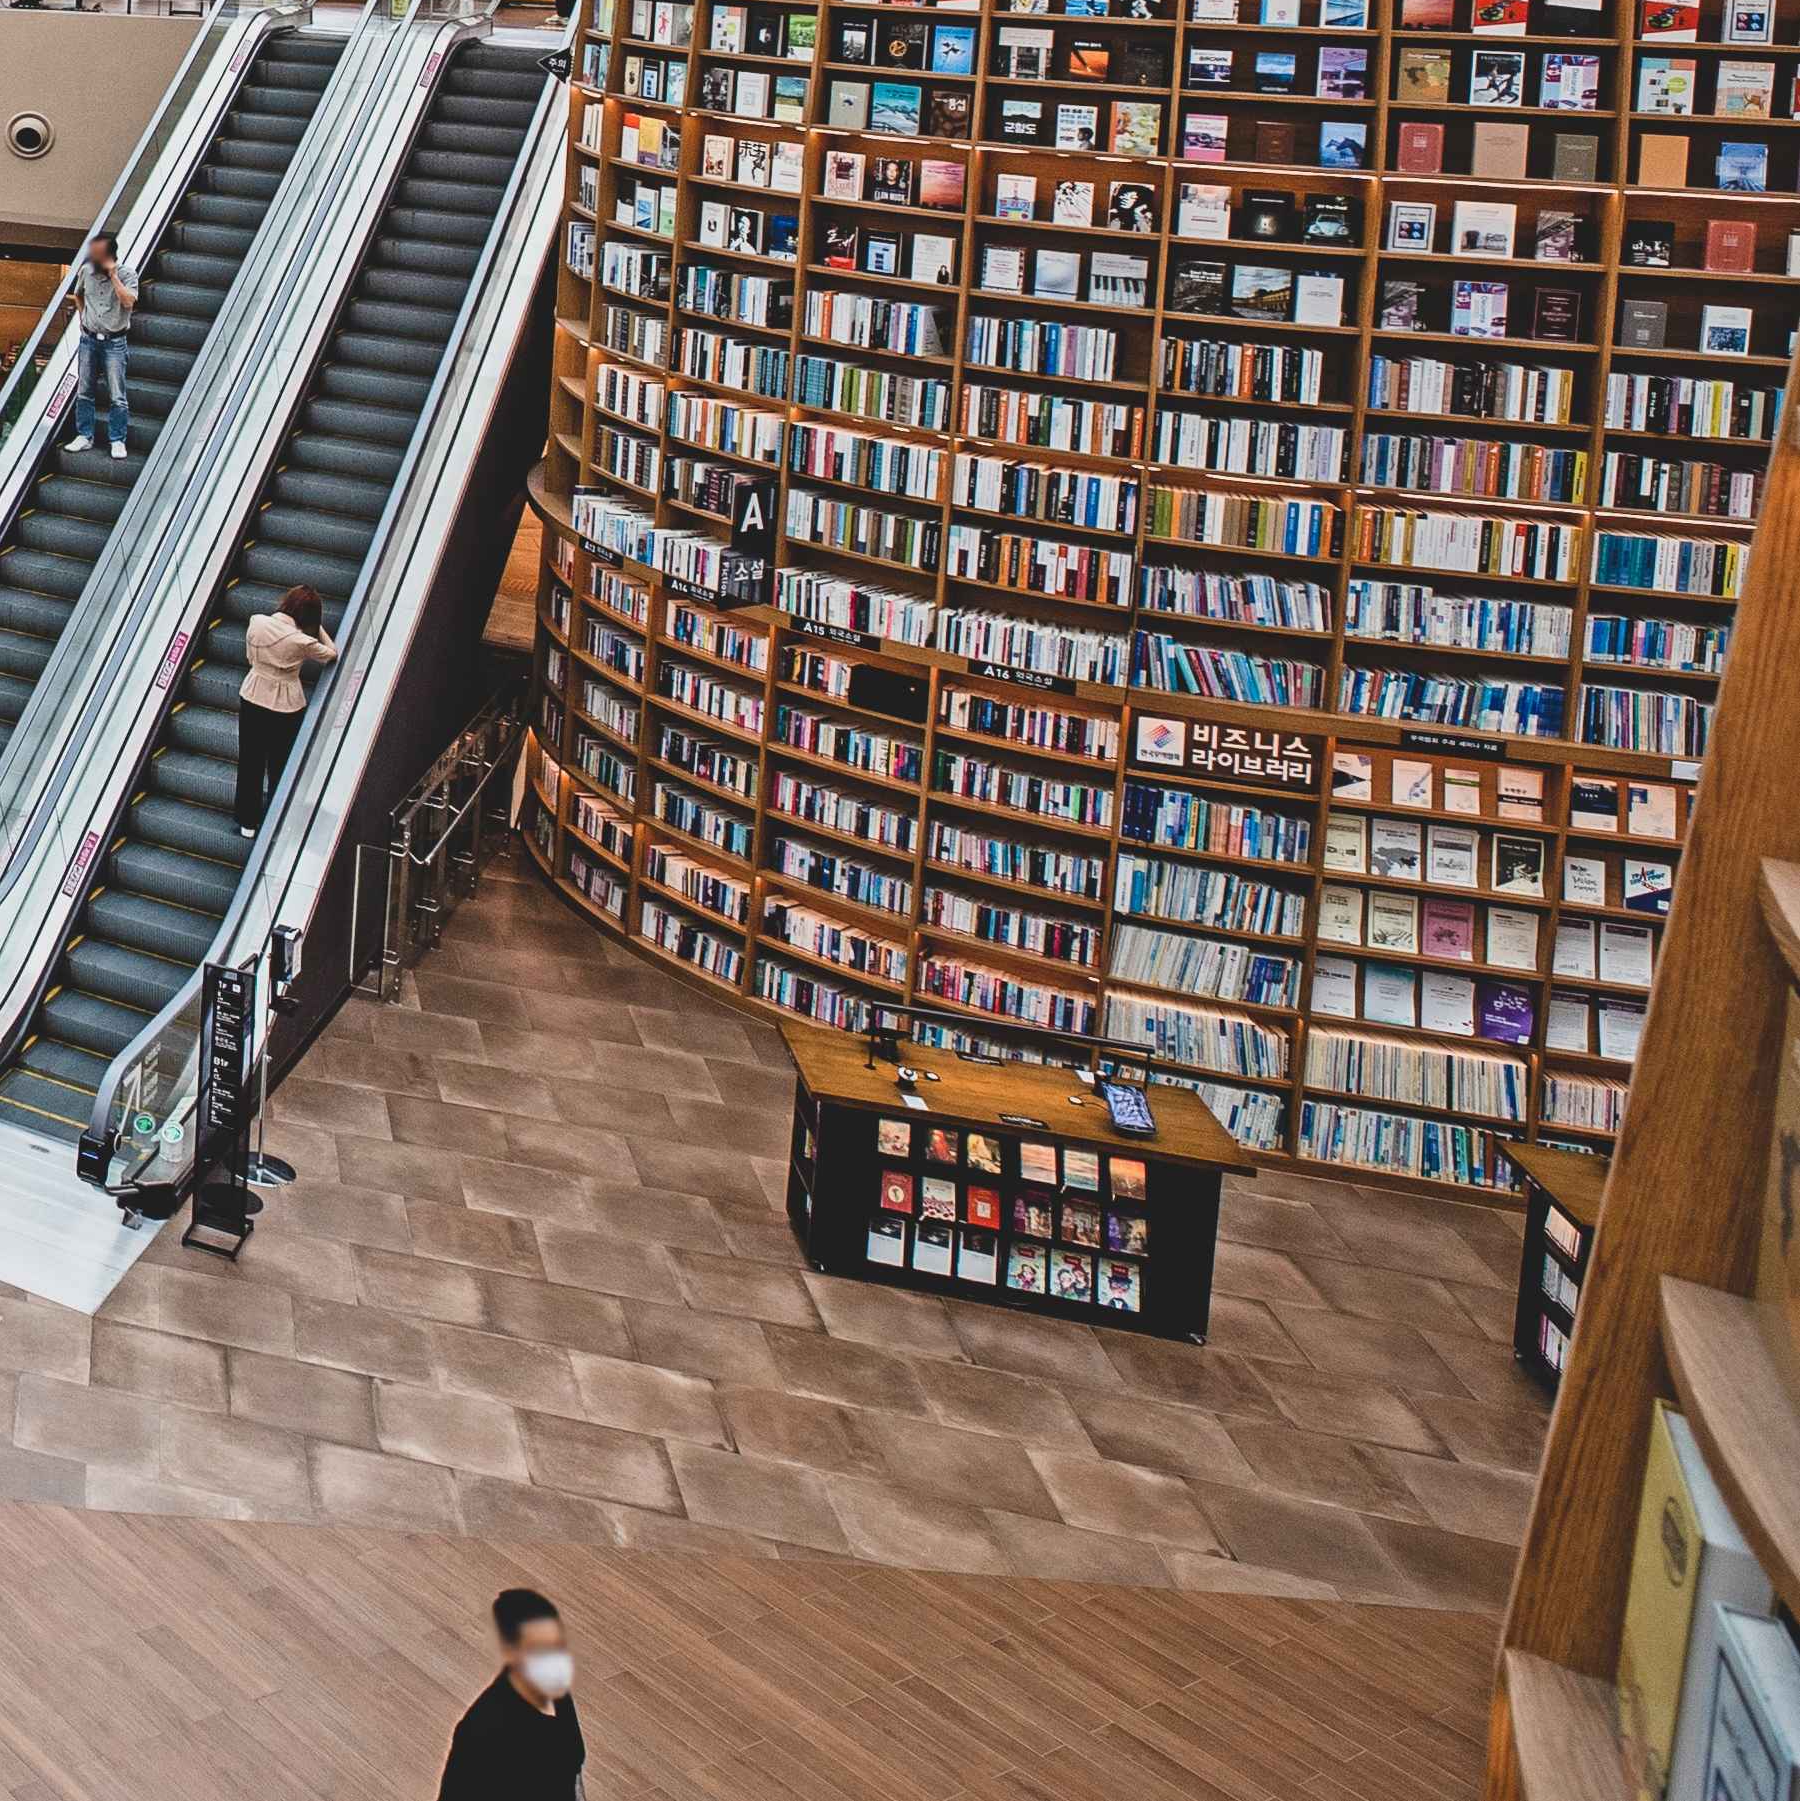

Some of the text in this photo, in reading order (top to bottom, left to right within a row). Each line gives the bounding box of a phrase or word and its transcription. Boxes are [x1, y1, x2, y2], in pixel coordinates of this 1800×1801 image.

[740, 493, 764, 533] A
[734, 559, 764, 582] 소설
[670, 581, 688, 593] A14
[803, 623, 826, 636] A15
[983, 665, 1010, 680] A16
[1193, 722, 1312, 759] 비즈니스
[1192, 748, 1312, 784] 라이브러리
